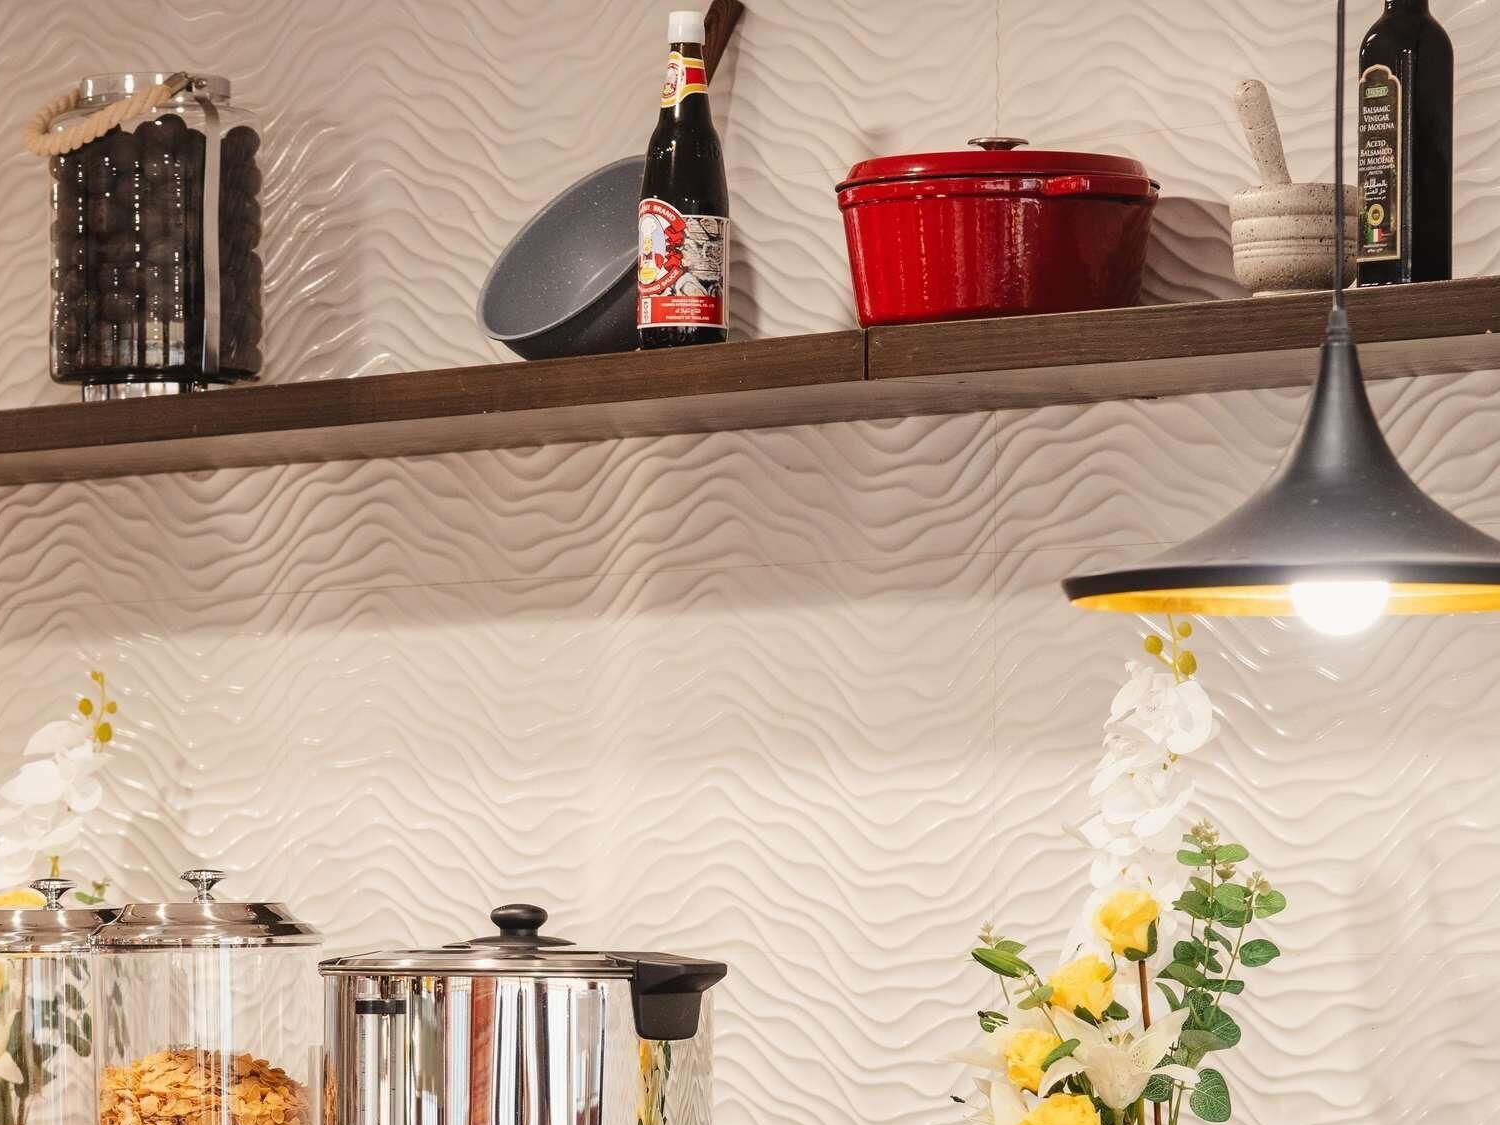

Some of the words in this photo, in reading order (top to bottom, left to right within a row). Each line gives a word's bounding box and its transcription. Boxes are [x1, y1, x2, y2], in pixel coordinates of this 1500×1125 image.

[1363, 104, 1391, 115] BALSAMIC
[1363, 114, 1390, 123] VINEGAR
[1367, 122, 1395, 131] MODENA
[653, 204, 676, 222] BRAND
